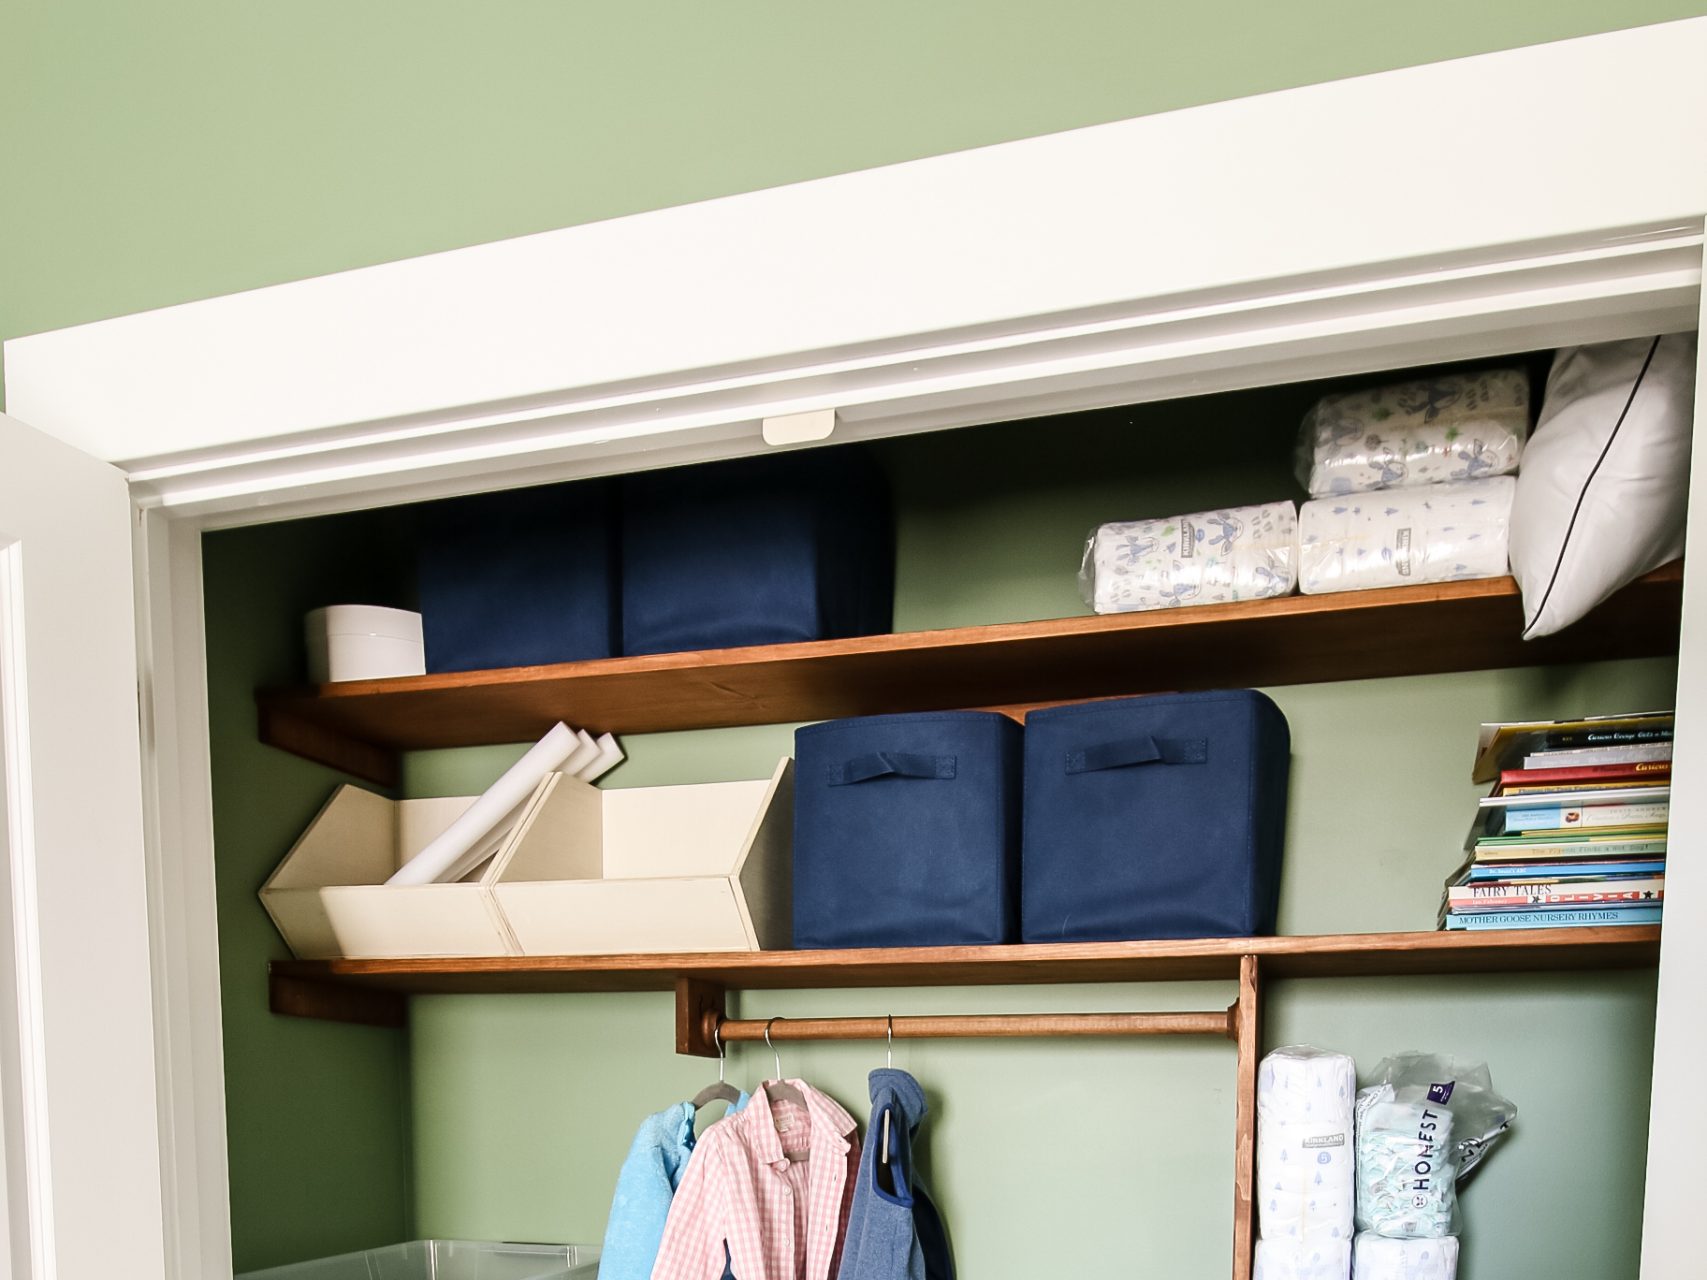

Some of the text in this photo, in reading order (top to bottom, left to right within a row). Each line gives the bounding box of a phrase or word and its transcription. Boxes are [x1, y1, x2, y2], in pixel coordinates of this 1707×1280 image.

[1635, 763, 1669, 771] Curious
[1473, 884, 1552, 898] FAIRY TALES
[1550, 892, 1633, 902] OLIVIA
[1459, 911, 1618, 924] MOTHER GOOSE NURSERY RHYMES
[1433, 1085, 1443, 1094] 5
[1412, 1108, 1439, 1190] HONEST
